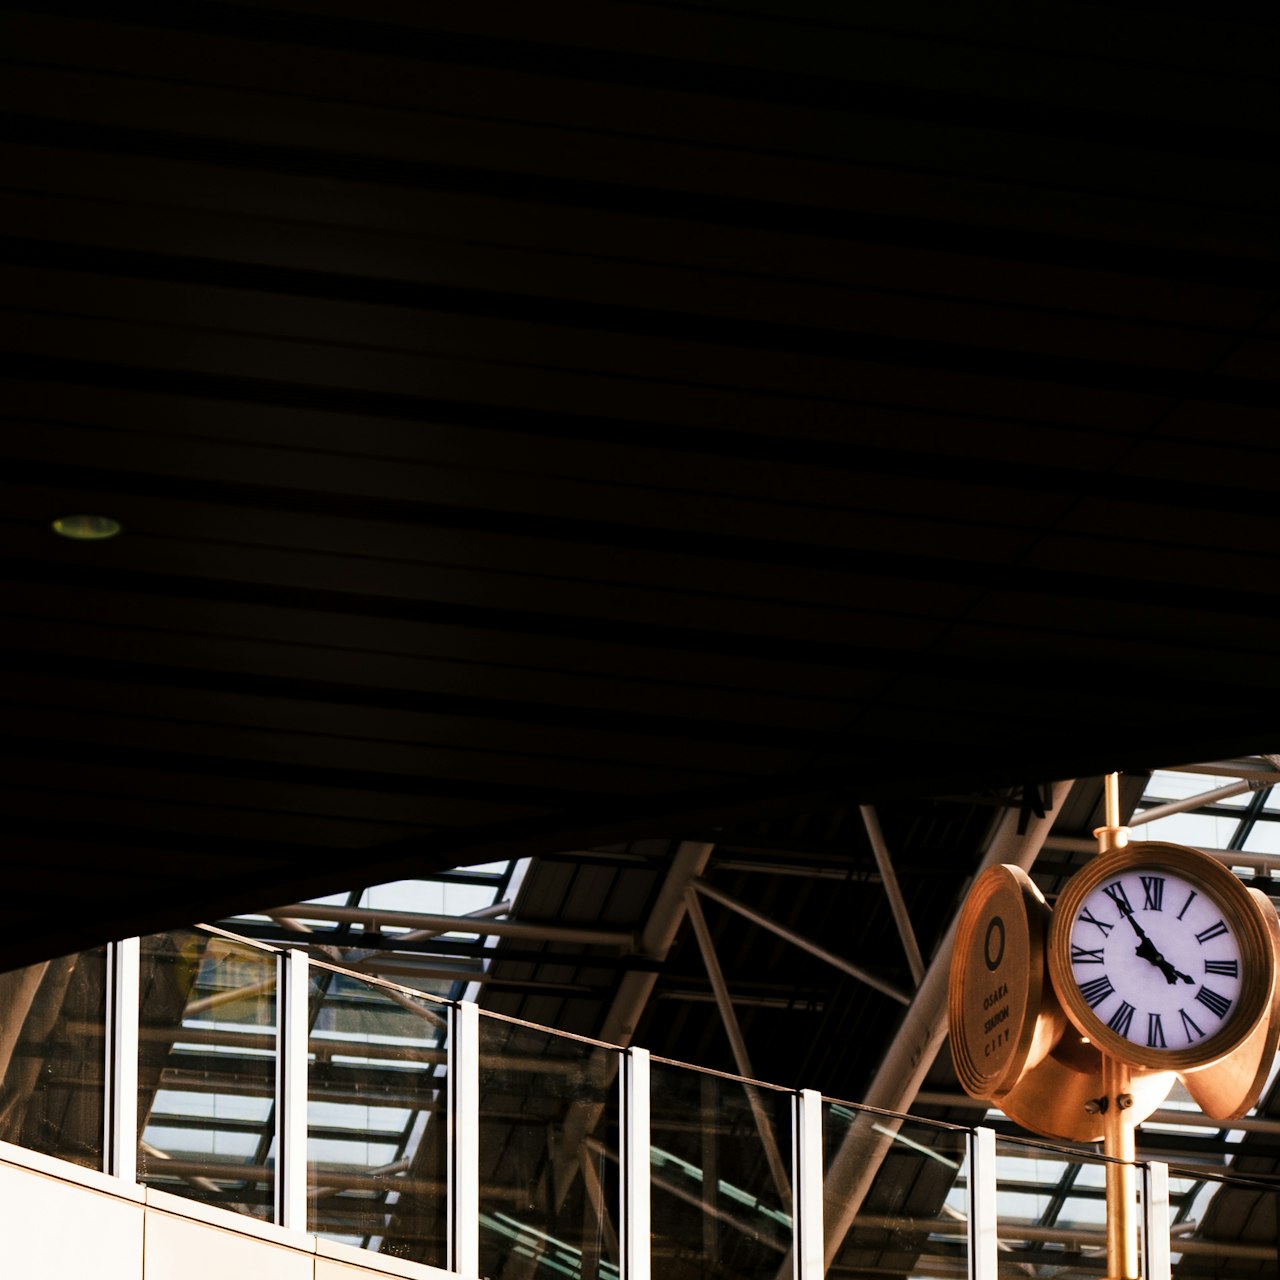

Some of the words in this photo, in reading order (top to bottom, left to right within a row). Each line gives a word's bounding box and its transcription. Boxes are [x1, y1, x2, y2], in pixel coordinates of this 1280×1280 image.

[1101, 880, 1135, 919] XI
[1139, 876, 1166, 912] XII
[1176, 890, 1198, 921] I
[1078, 907, 1114, 938] X
[1194, 919, 1229, 945] II
[1071, 943, 1105, 965] IX
[1204, 959, 1238, 979] III
[983, 983, 1008, 1011] OSAKA
[1078, 975, 1116, 1010] VIII
[1194, 984, 1233, 1020] IIII
[984, 1005, 1009, 1034] STATION
[1107, 1000, 1137, 1039] VII
[1146, 1012, 1168, 1048] VI
[1178, 1008, 1206, 1044] V
[984, 1028, 1009, 1057] CITY
